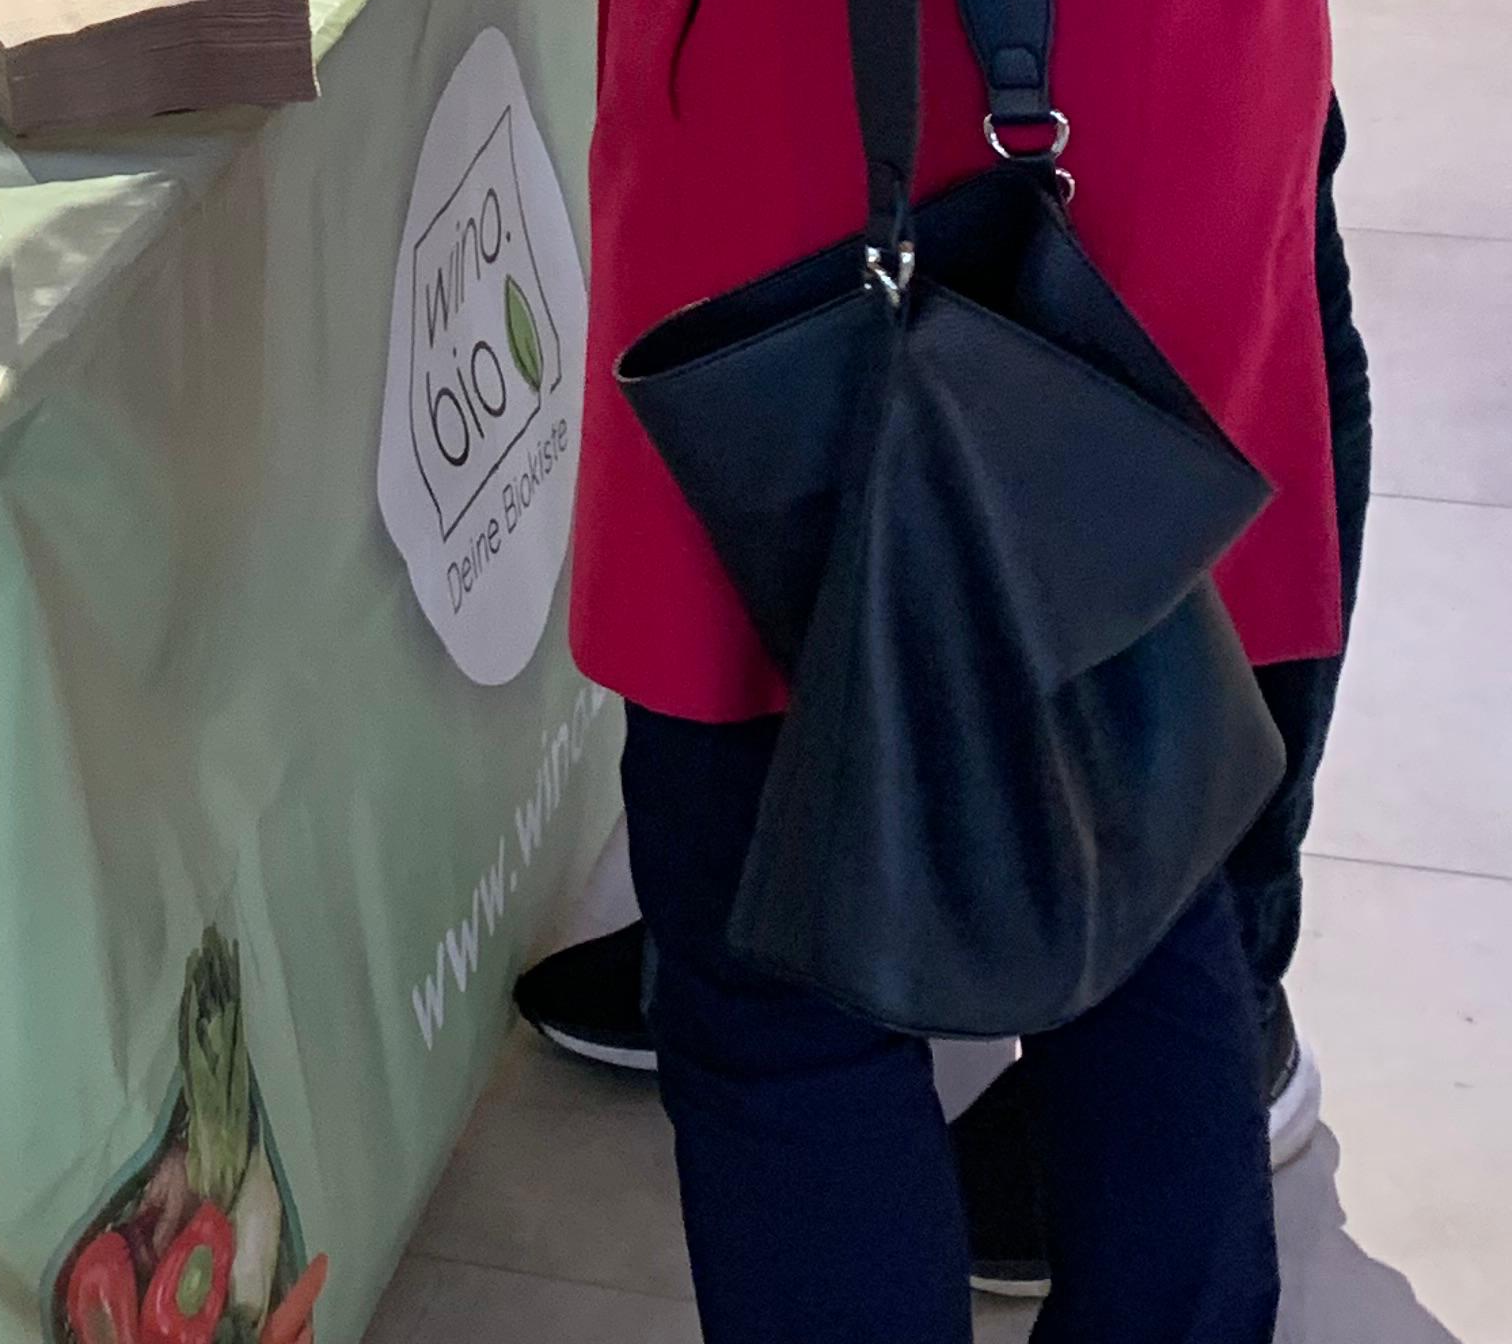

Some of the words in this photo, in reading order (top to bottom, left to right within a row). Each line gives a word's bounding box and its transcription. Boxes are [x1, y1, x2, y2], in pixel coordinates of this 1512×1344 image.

[426, 341, 507, 467] bio
[447, 518, 501, 615] Deine
[502, 418, 568, 534] Biokiste
